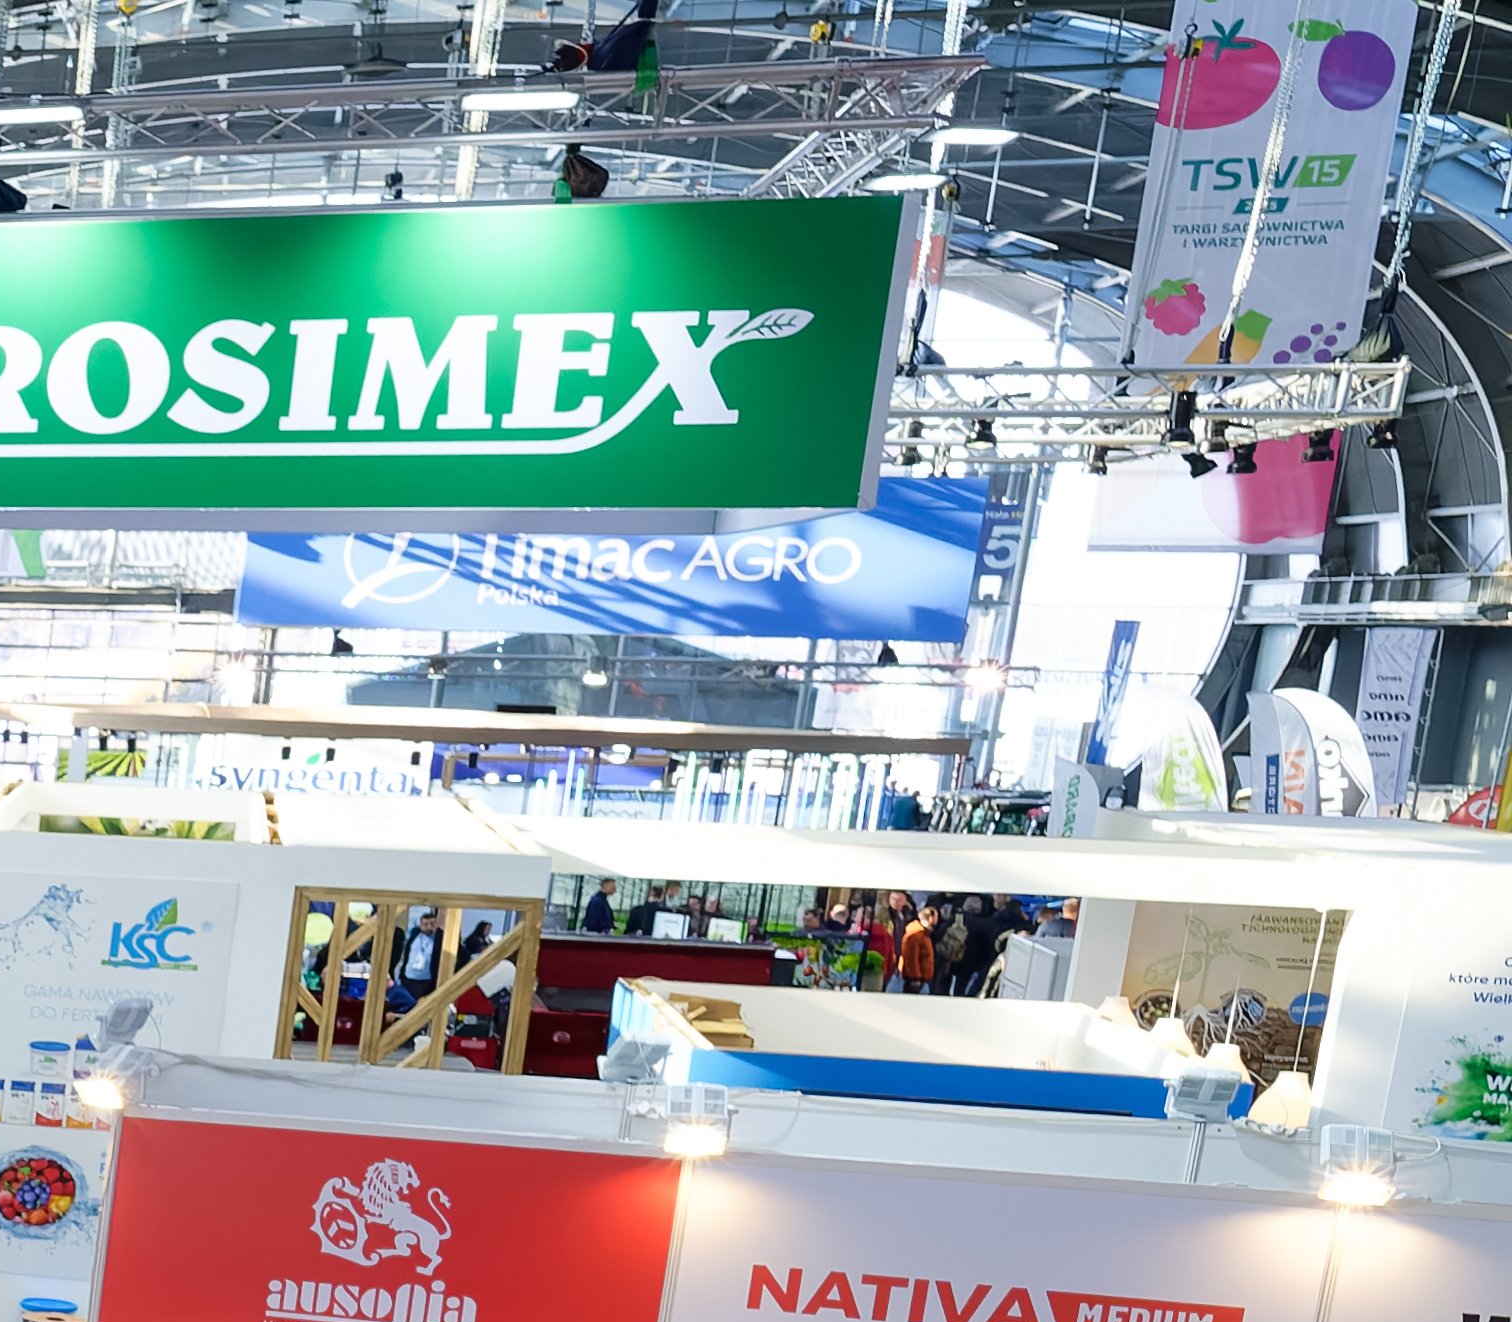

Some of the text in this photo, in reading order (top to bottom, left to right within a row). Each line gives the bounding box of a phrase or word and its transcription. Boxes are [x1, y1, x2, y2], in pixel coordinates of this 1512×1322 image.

[1182, 156, 1341, 191] TSW 15
[1172, 220, 1344, 235] TARGI SADWNICTWA
[983, 525, 1018, 570] 5
[680, 535, 862, 585] AGRO
[477, 582, 559, 607] Polska
[1449, 973, 1489, 984] które
[24, 984, 175, 1006] GAMA NAWOÓW
[30, 1005, 57, 1019] DO
